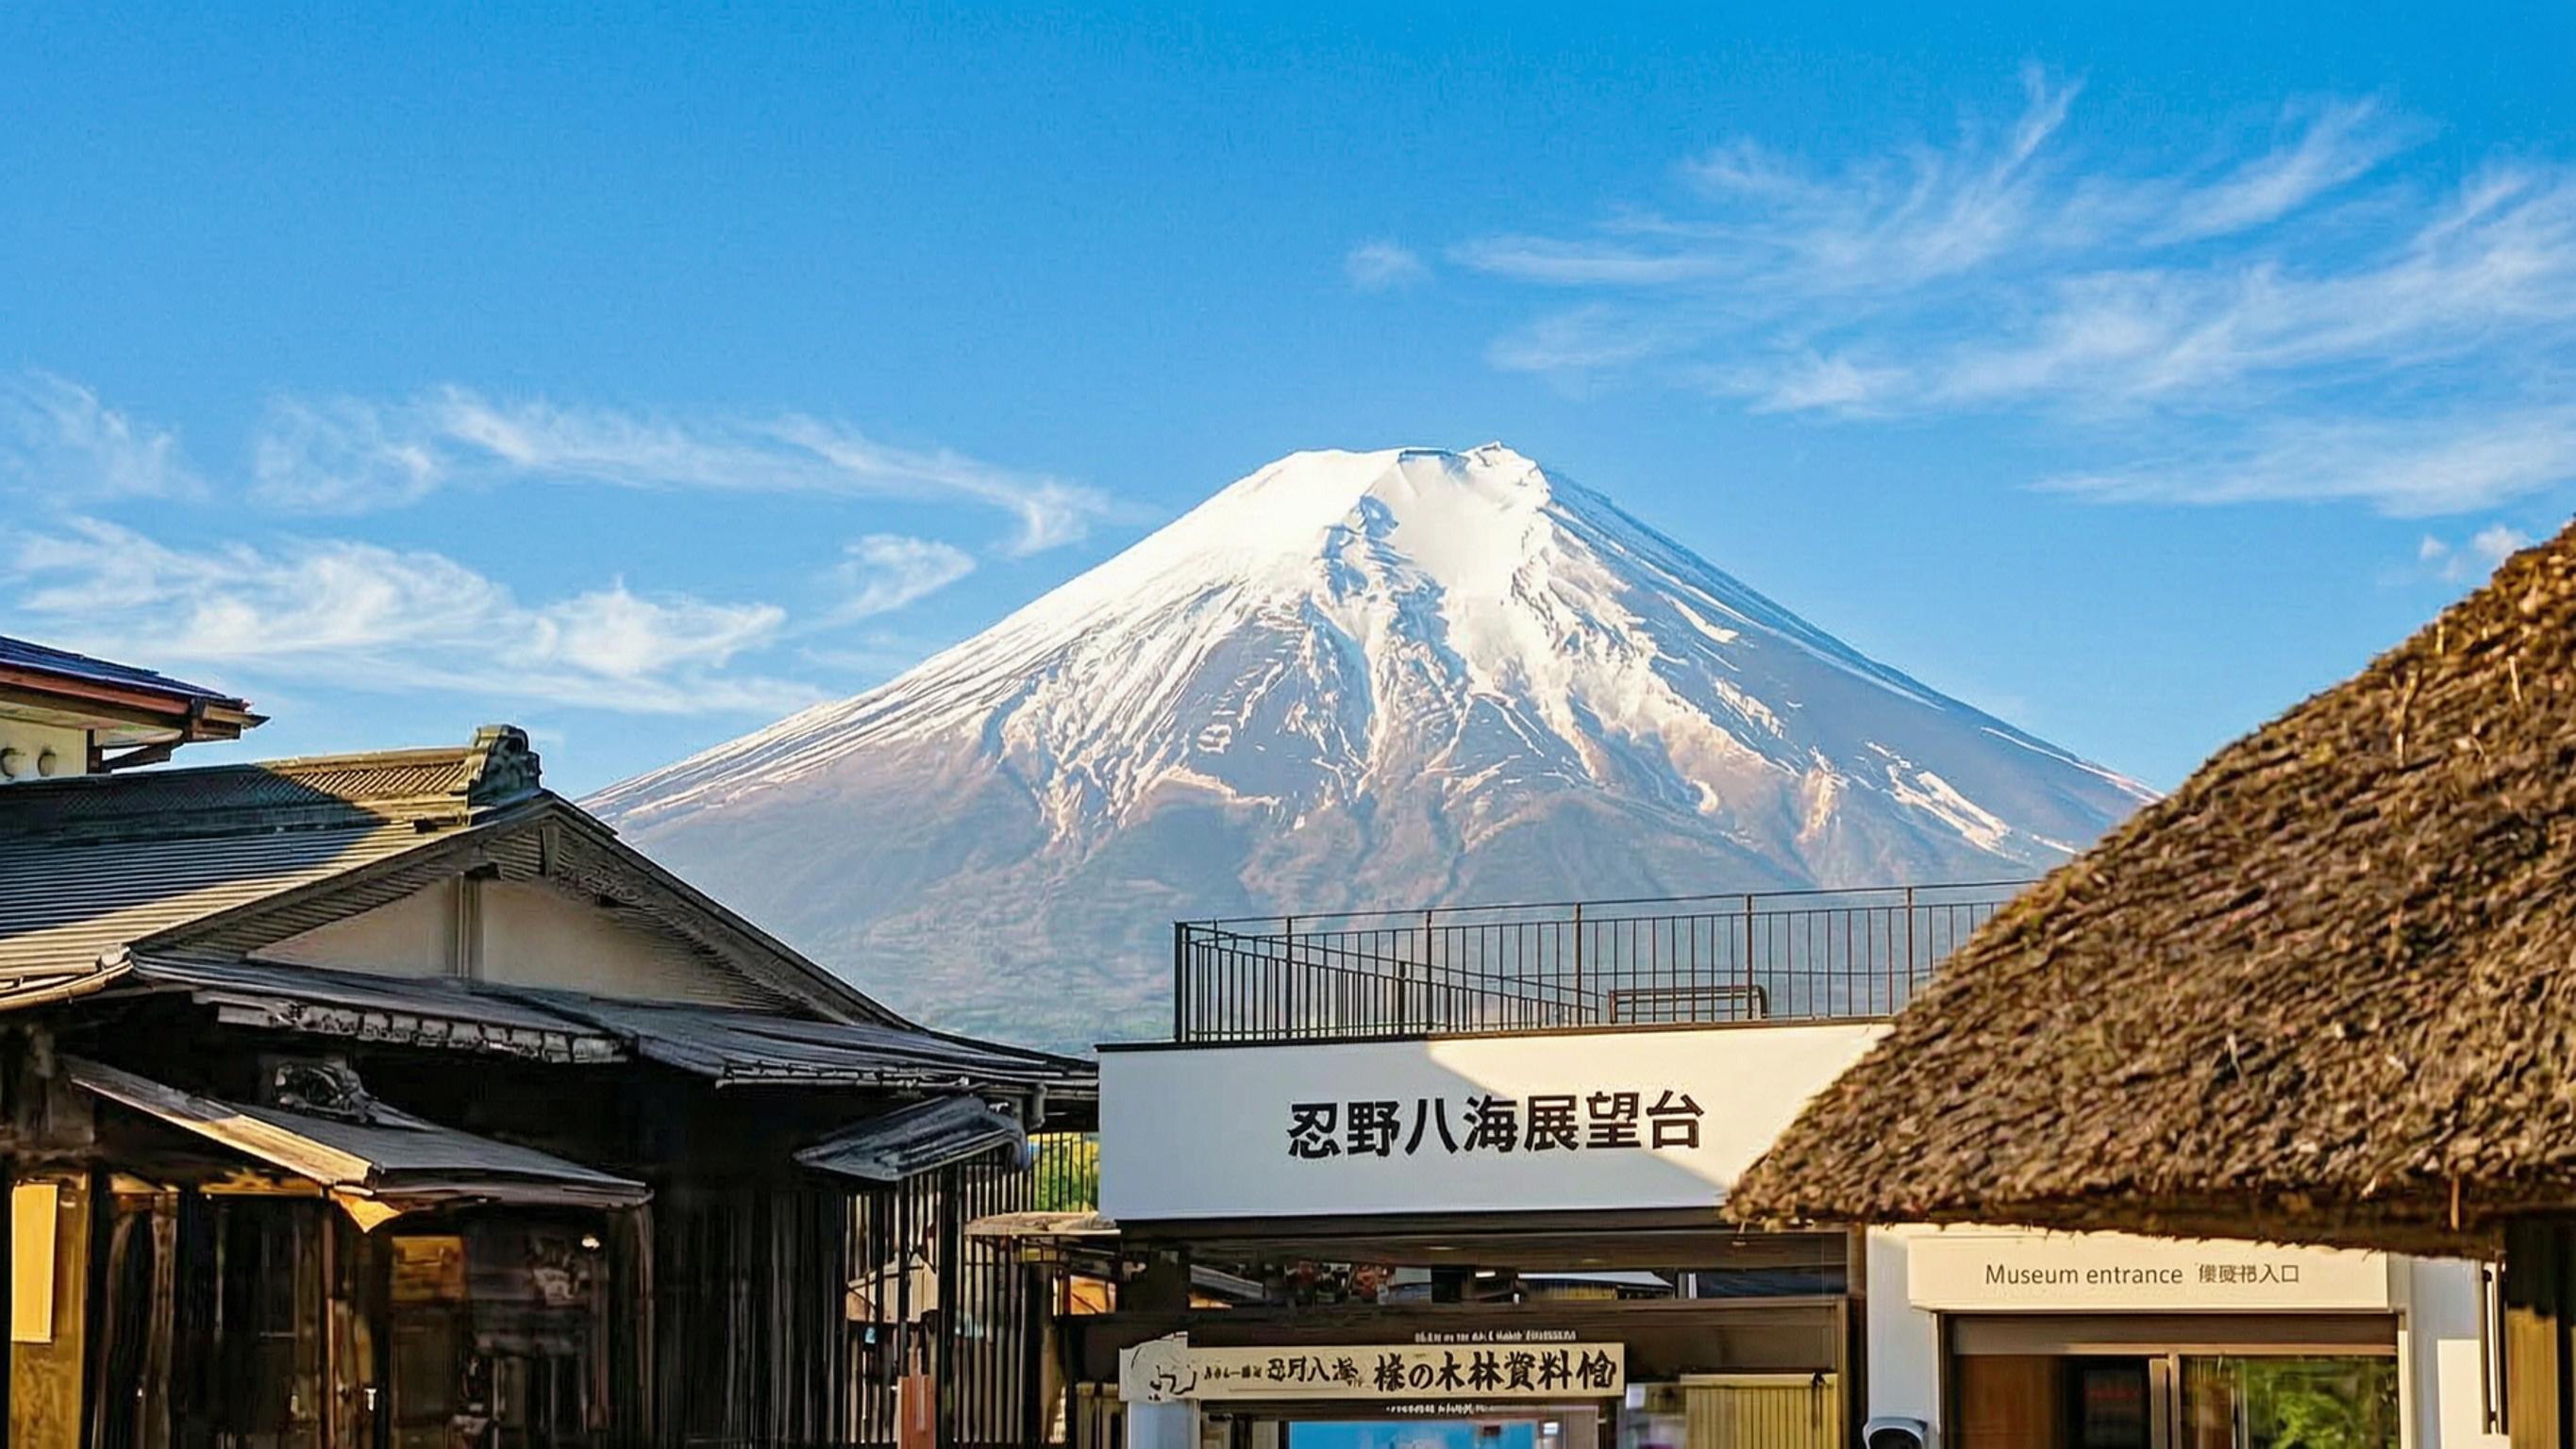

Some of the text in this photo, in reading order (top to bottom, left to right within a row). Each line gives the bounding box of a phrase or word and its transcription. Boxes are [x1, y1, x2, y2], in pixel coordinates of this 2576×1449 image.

[1286, 1091, 1704, 1158] 忍野八海展望台
[1985, 1264, 2079, 1284] Museum
[2086, 1266, 2183, 1284] entrance
